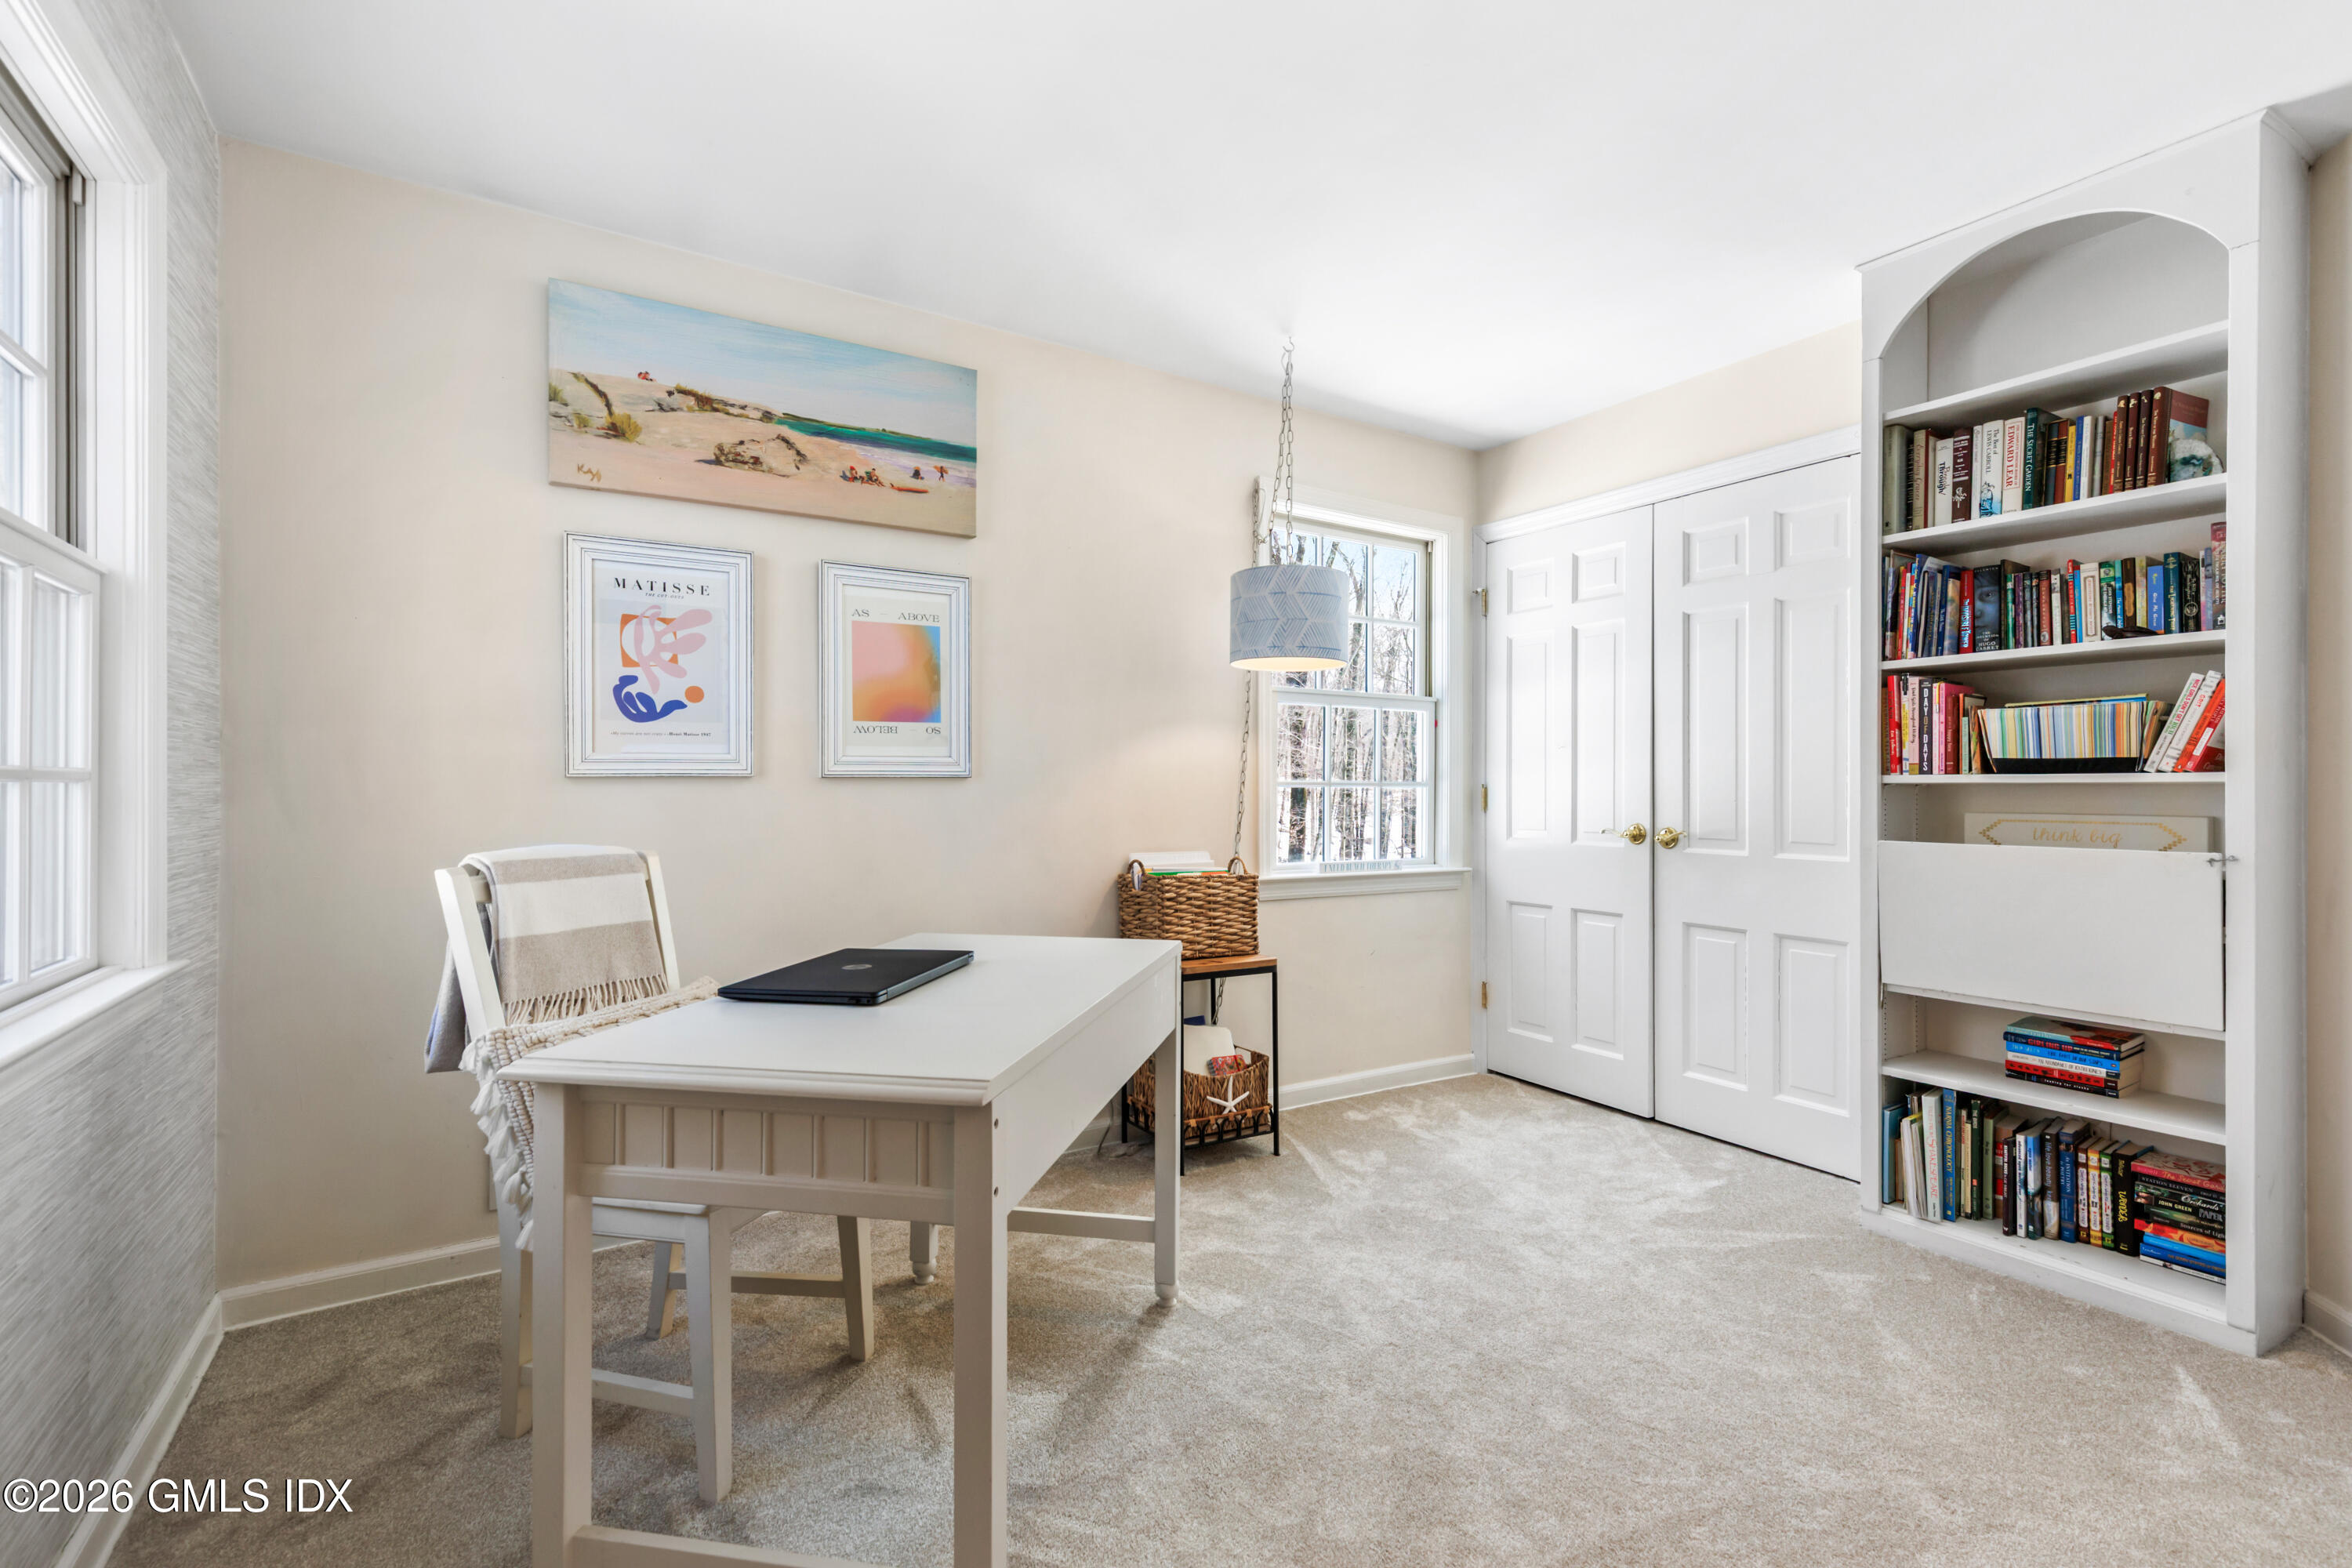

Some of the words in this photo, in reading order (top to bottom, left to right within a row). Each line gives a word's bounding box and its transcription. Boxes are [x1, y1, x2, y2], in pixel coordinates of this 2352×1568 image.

[2006, 425, 2015, 463] EDWARD
[2005, 465, 2014, 488] LEAR
[614, 577, 710, 597] MATISSE
[851, 608, 870, 618] AS
[898, 612, 940, 622] ABOVE
[2191, 678, 2201, 689] NICE
[2185, 688, 2197, 702] GIRLS
[2196, 694, 2205, 708] GRIT
[2180, 700, 2190, 713] DON'T
[2175, 712, 2183, 722] GET
[854, 725, 898, 734] BELOW
[926, 726, 941, 735] SO
[1923, 717, 1929, 734] OF
[2168, 721, 2179, 735] RICH
[2032, 828, 2082, 842] think
[2089, 829, 2122, 848] big
[2027, 1038, 2060, 1051] GIRLING
[1926, 1137, 1938, 1199] SHAKESPEARE
[2141, 1177, 2169, 1186] STATION
[2169, 1181, 2194, 1192] ELEVEN
[2162, 1171, 2173, 1180] The
[2179, 1174, 2201, 1185] Secret
[2203, 1181, 2225, 1192] Gard
[2118, 1191, 2128, 1222] WONDER
[2180, 1194, 2223, 1210] Orchards
[2174, 1203, 2192, 1212] GREEN
[2198, 1208, 2223, 1222] PAPER
[2180, 1221, 2203, 1233] Sources
[2212, 1230, 2225, 1240] Ligh
